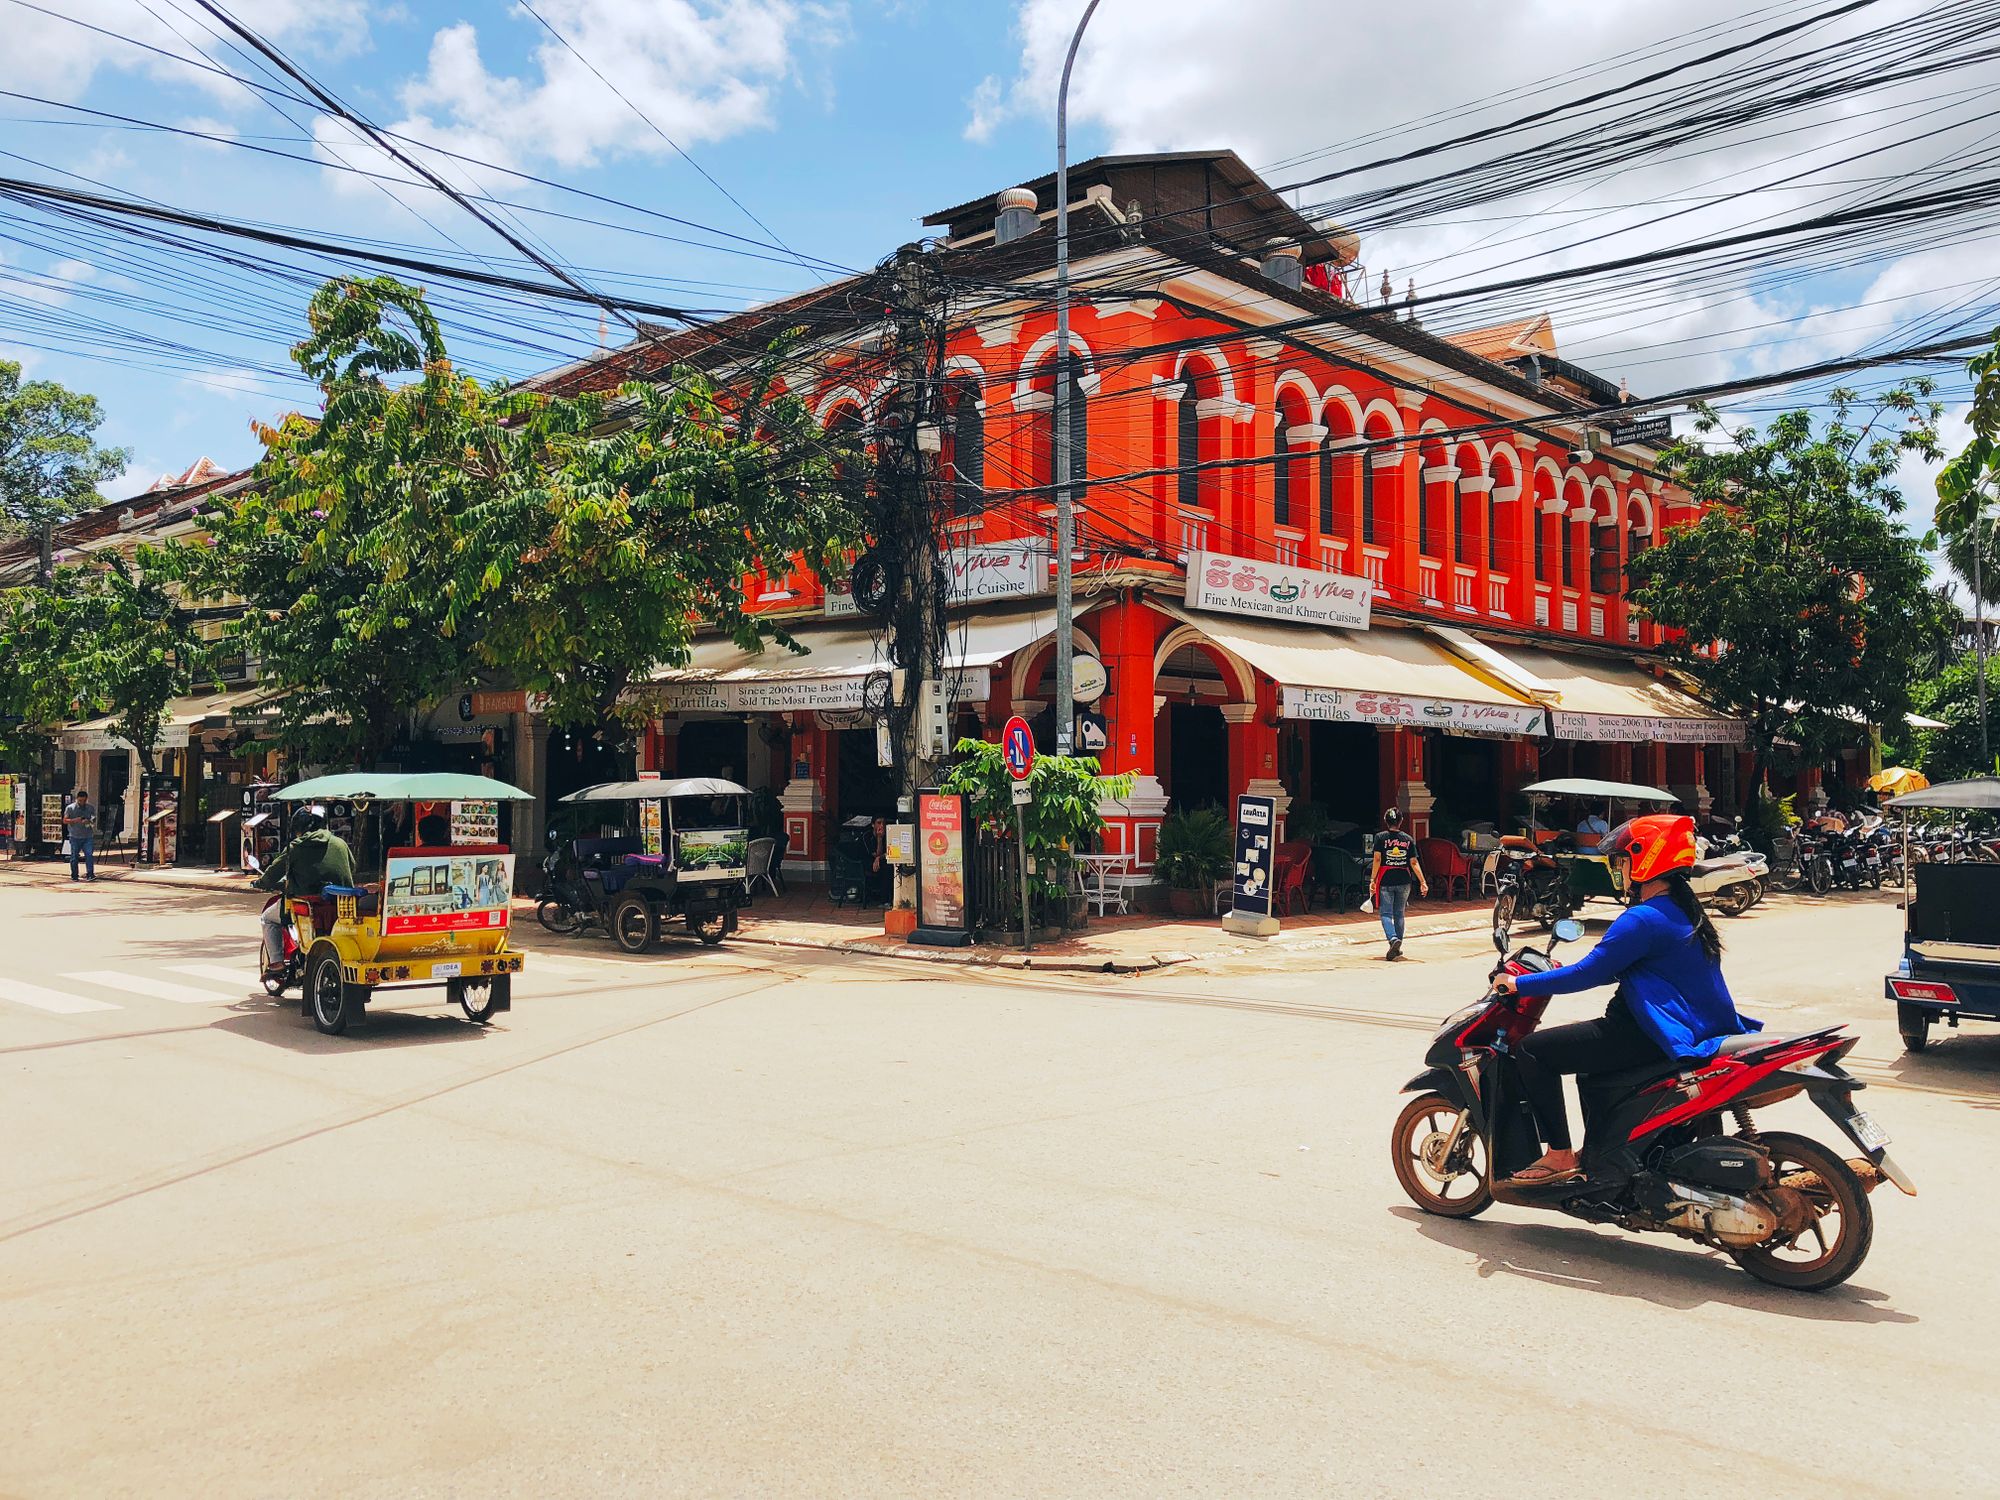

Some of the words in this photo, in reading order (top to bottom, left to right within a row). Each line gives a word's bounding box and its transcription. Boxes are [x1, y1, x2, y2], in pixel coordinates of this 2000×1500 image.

[831, 600, 854, 612] Fine
[977, 580, 1025, 595] Cuisine
[1204, 592, 1227, 606] Fine
[1230, 596, 1273, 612] Mexican
[1276, 604, 1293, 615] and
[1296, 606, 1327, 620] Khmer
[1329, 611, 1362, 624] Cuisine
[681, 684, 717, 695] Fresh
[738, 687, 765, 695] Since
[797, 684, 817, 693] The
[821, 683, 842, 692] Best
[1304, 688, 1341, 704] Fresh
[673, 696, 727, 708] Tortillas
[738, 696, 757, 706] Sold
[761, 696, 780, 705] The
[783, 696, 806, 705] Most
[809, 694, 842, 704] Frozen
[1294, 703, 1350, 720] Tortillas
[1363, 714, 1386, 723] Fine
[1389, 715, 1432, 727] Mexican
[1433, 717, 1451, 727] and
[1453, 719, 1483, 731] Khmer
[1485, 723, 1519, 733] Cuisine
[1561, 713, 1588, 727] Fresh
[1598, 716, 1620, 727] Since
[1675, 720, 1703, 730] Mexican
[1554, 725, 1593, 739] Tortillas
[1599, 728, 1616, 739] Sold
[1618, 729, 1631, 739] The
[1632, 730, 1650, 740] Mos
